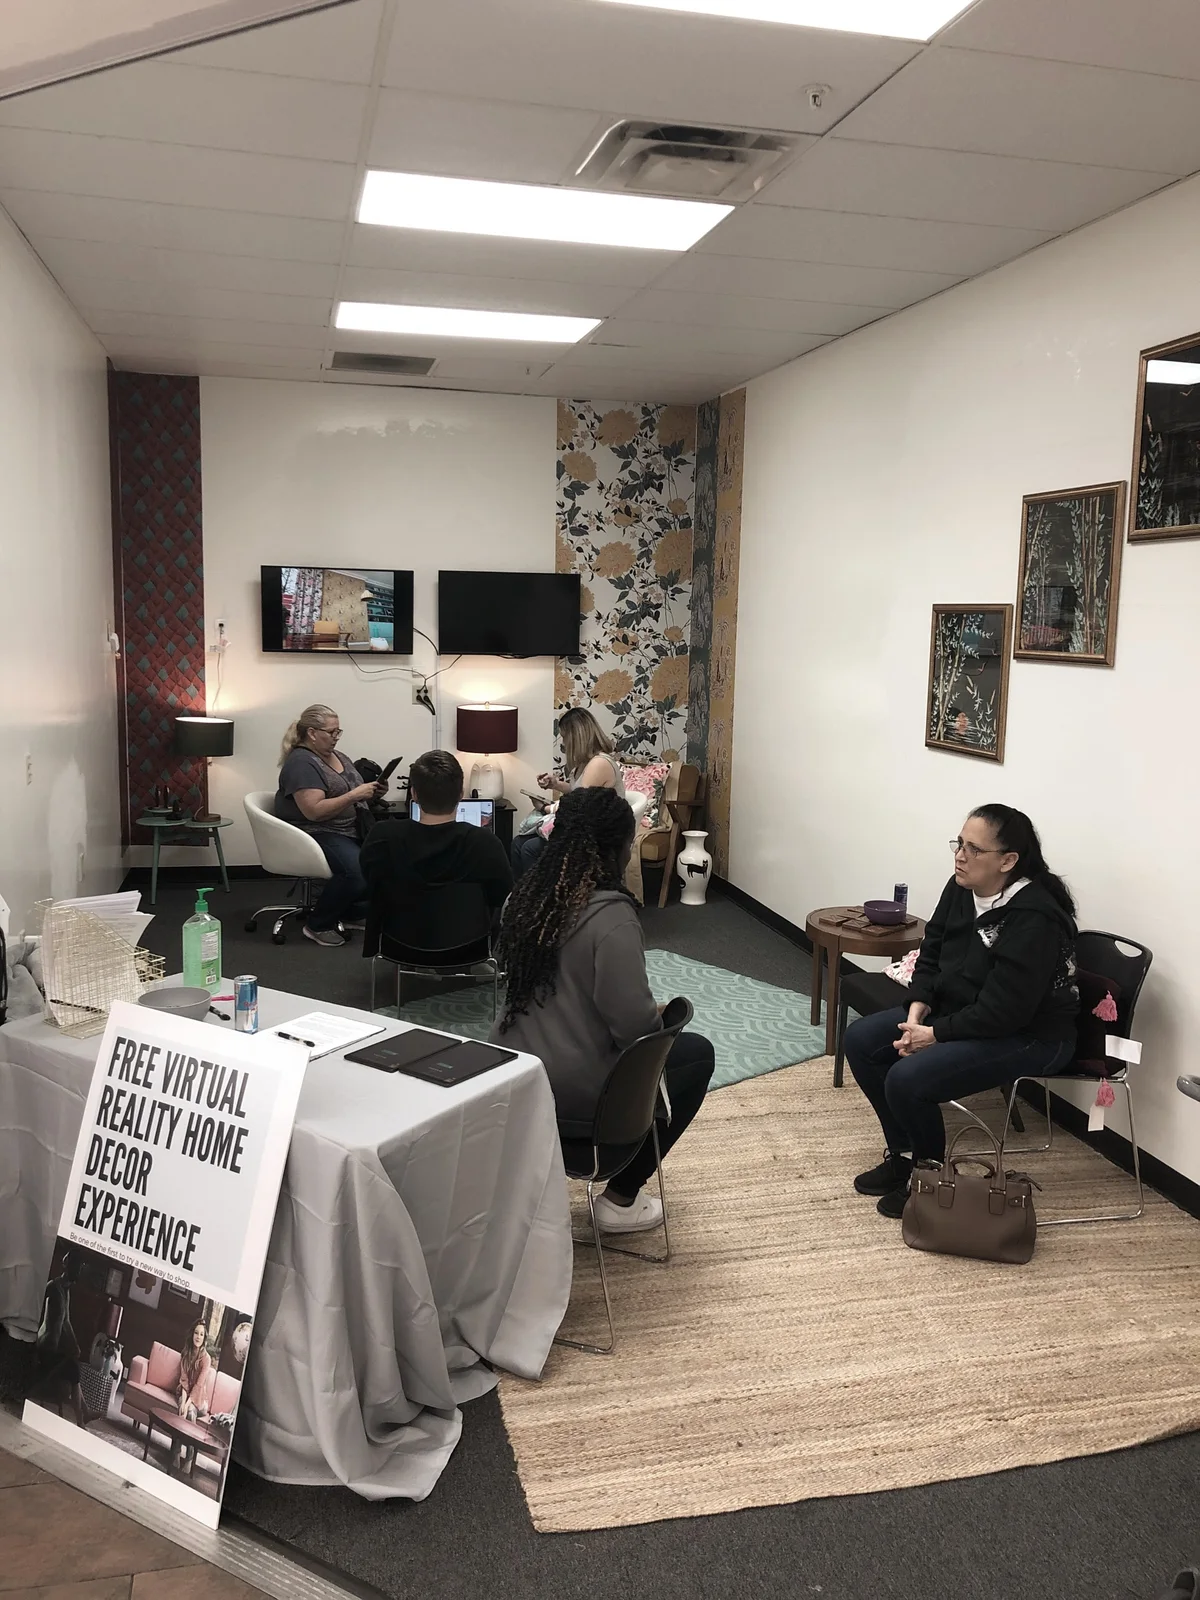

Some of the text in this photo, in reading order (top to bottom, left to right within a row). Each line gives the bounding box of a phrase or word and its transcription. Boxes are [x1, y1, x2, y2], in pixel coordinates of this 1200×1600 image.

[108, 1036, 249, 1118] FREE VIRTUAL
[85, 1134, 153, 1196] DECOR
[96, 1085, 249, 1174] REALITY HOME
[74, 1183, 201, 1271] EXPERIENCE
[79, 1237, 89, 1245] one
[96, 1243, 107, 1252] the
[107, 1247, 118, 1257] first
[126, 1255, 135, 1266] try
[139, 1262, 153, 1272] new
[153, 1268, 166, 1280] way
[174, 1276, 191, 1288] shop.
